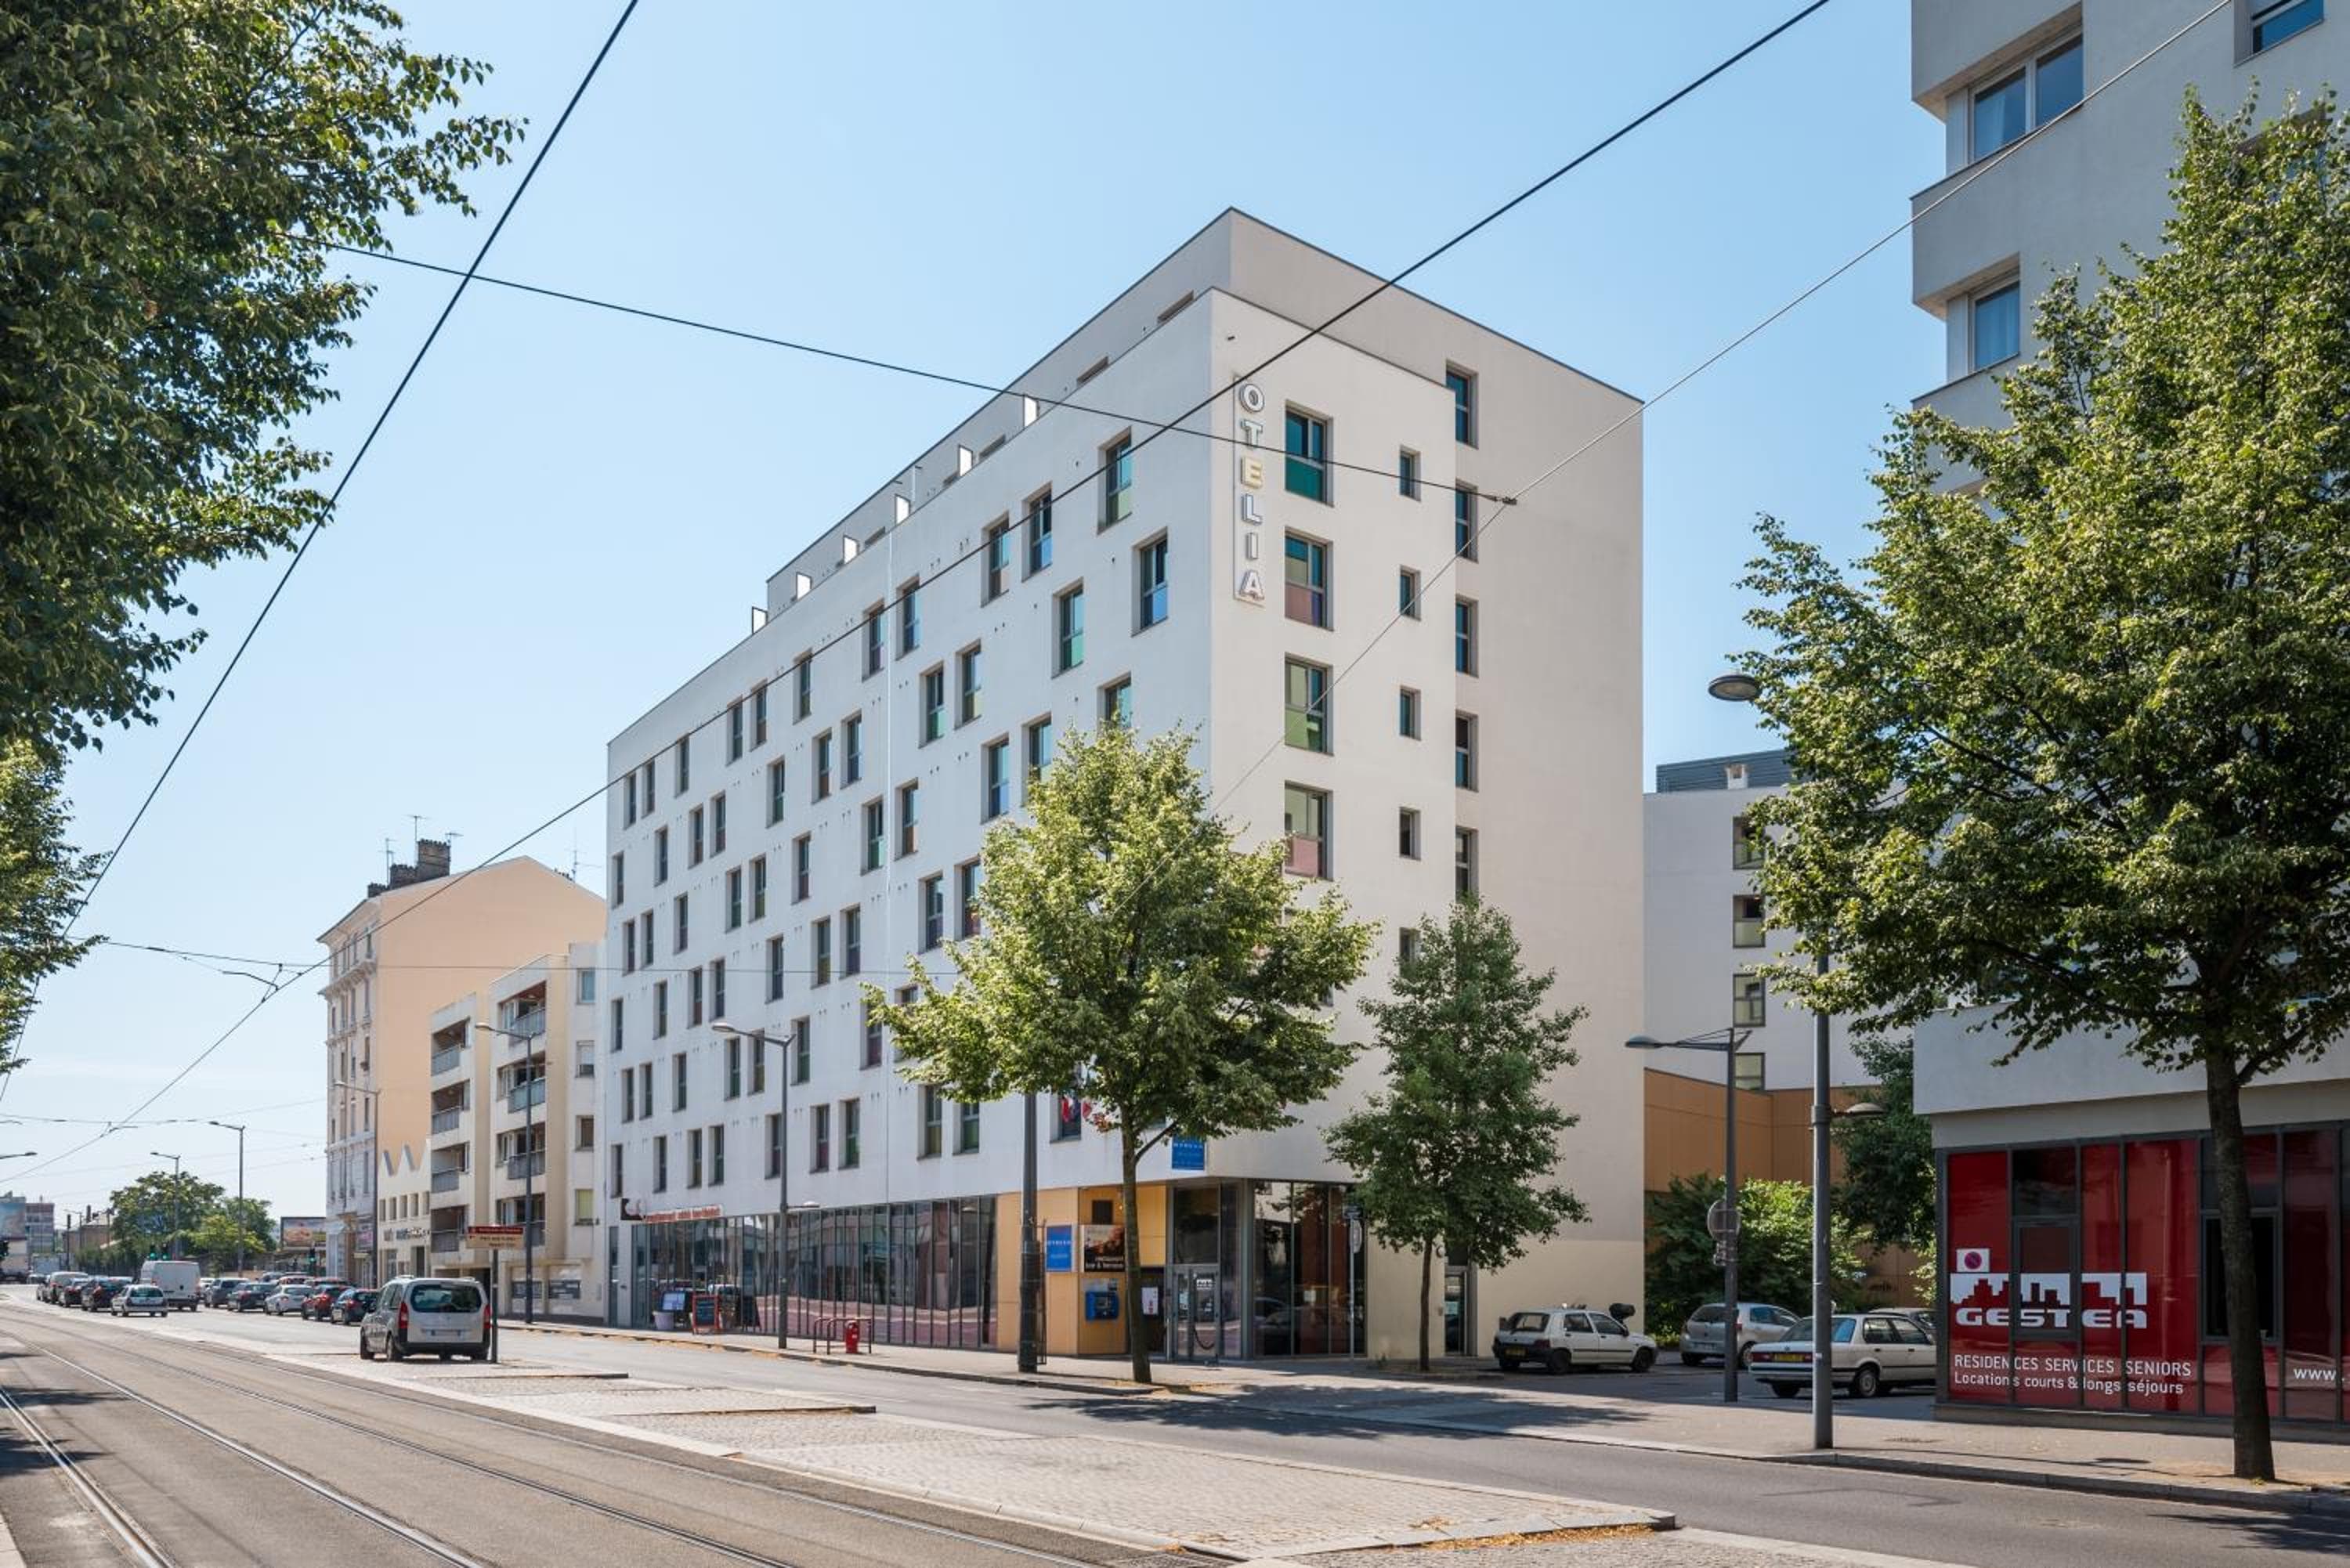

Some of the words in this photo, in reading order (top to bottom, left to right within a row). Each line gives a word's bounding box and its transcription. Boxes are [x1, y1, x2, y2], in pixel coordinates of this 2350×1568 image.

[1239, 383, 1265, 602] OTELIA
[1955, 1307, 2147, 1329] GESTEA
[1954, 1354, 2039, 1371] RESIDENCES
[2044, 1357, 2115, 1374] SERVICES
[2125, 1360, 2192, 1377] SENIORS
[1954, 1371, 2021, 1387] Locations
[2025, 1376, 2065, 1389] courts
[2067, 1376, 2079, 1389] &
[2083, 1377, 2121, 1395] longs
[2128, 1378, 2184, 1396] séjours
